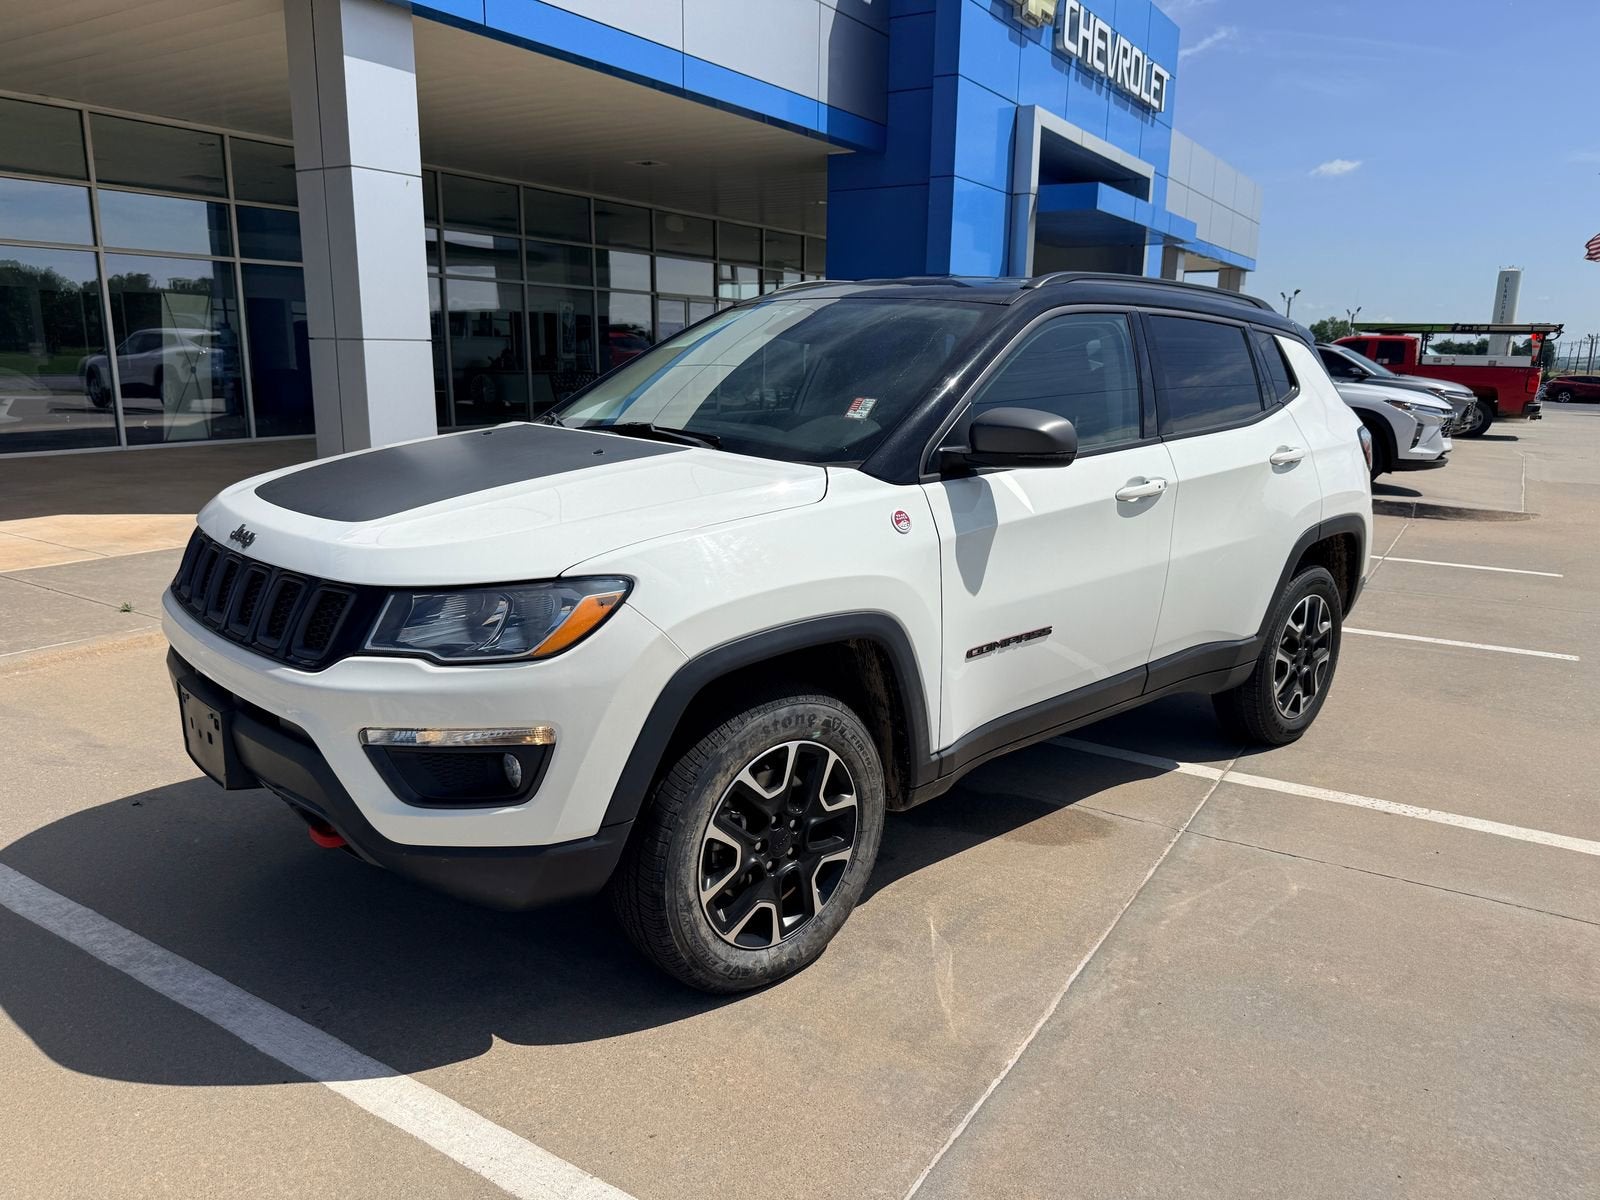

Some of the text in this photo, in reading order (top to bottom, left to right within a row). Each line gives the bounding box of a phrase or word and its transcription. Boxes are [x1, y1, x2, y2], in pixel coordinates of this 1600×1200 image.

[1064, 0, 1170, 112] CHEVROLET
[1499, 276, 1510, 323] BLANCHAR
[230, 523, 257, 549] Jeep
[965, 625, 1053, 659] COMPASS
